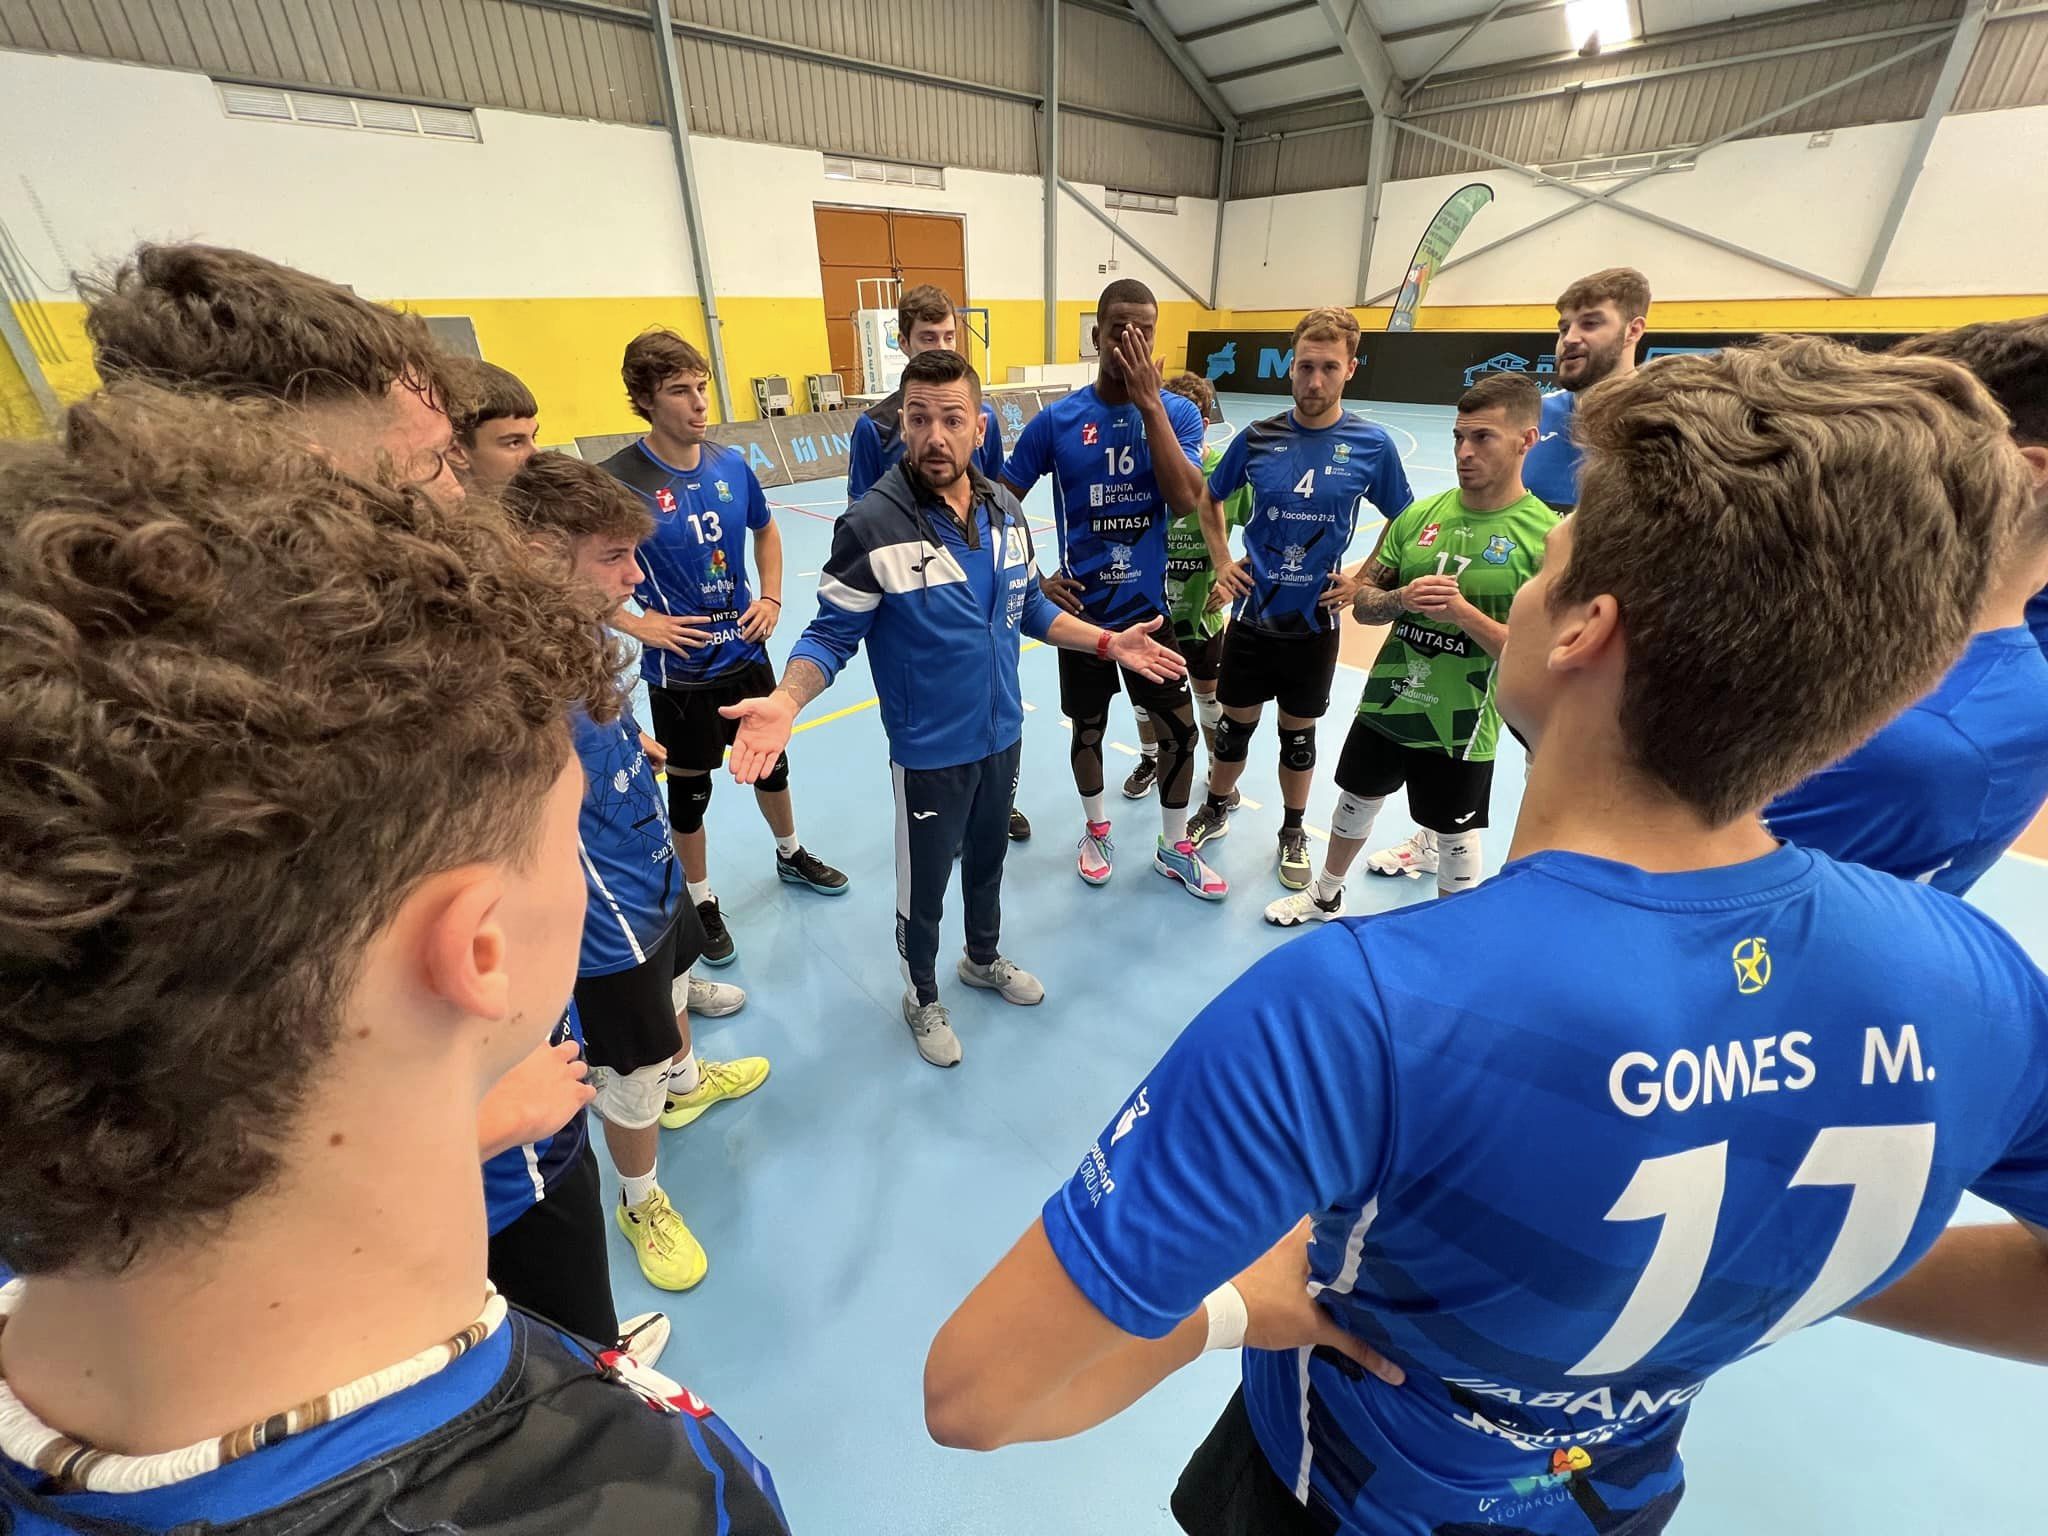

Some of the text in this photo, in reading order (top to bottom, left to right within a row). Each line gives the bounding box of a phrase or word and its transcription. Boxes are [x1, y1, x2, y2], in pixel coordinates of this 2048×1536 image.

[1257, 348, 1294, 378] M
[1105, 446, 1135, 476] 16
[1105, 483, 1134, 494] XUNTA
[1293, 468, 1315, 498] 4
[1105, 491, 1152, 504] DE GALICIA
[1103, 516, 1150, 531] INTASA
[1281, 510, 1318, 521] Xacobeo
[688, 511, 722, 545] 13
[1099, 571, 1111, 581] San
[1168, 560, 1204, 571] NTASA
[1267, 569, 1279, 580] San
[1435, 551, 1472, 580] 17
[1409, 627, 1465, 655] INTASA
[651, 844, 668, 864] San
[1608, 1024, 1937, 1118] GOMES M.
[1442, 1376, 1706, 1420] ABANC
